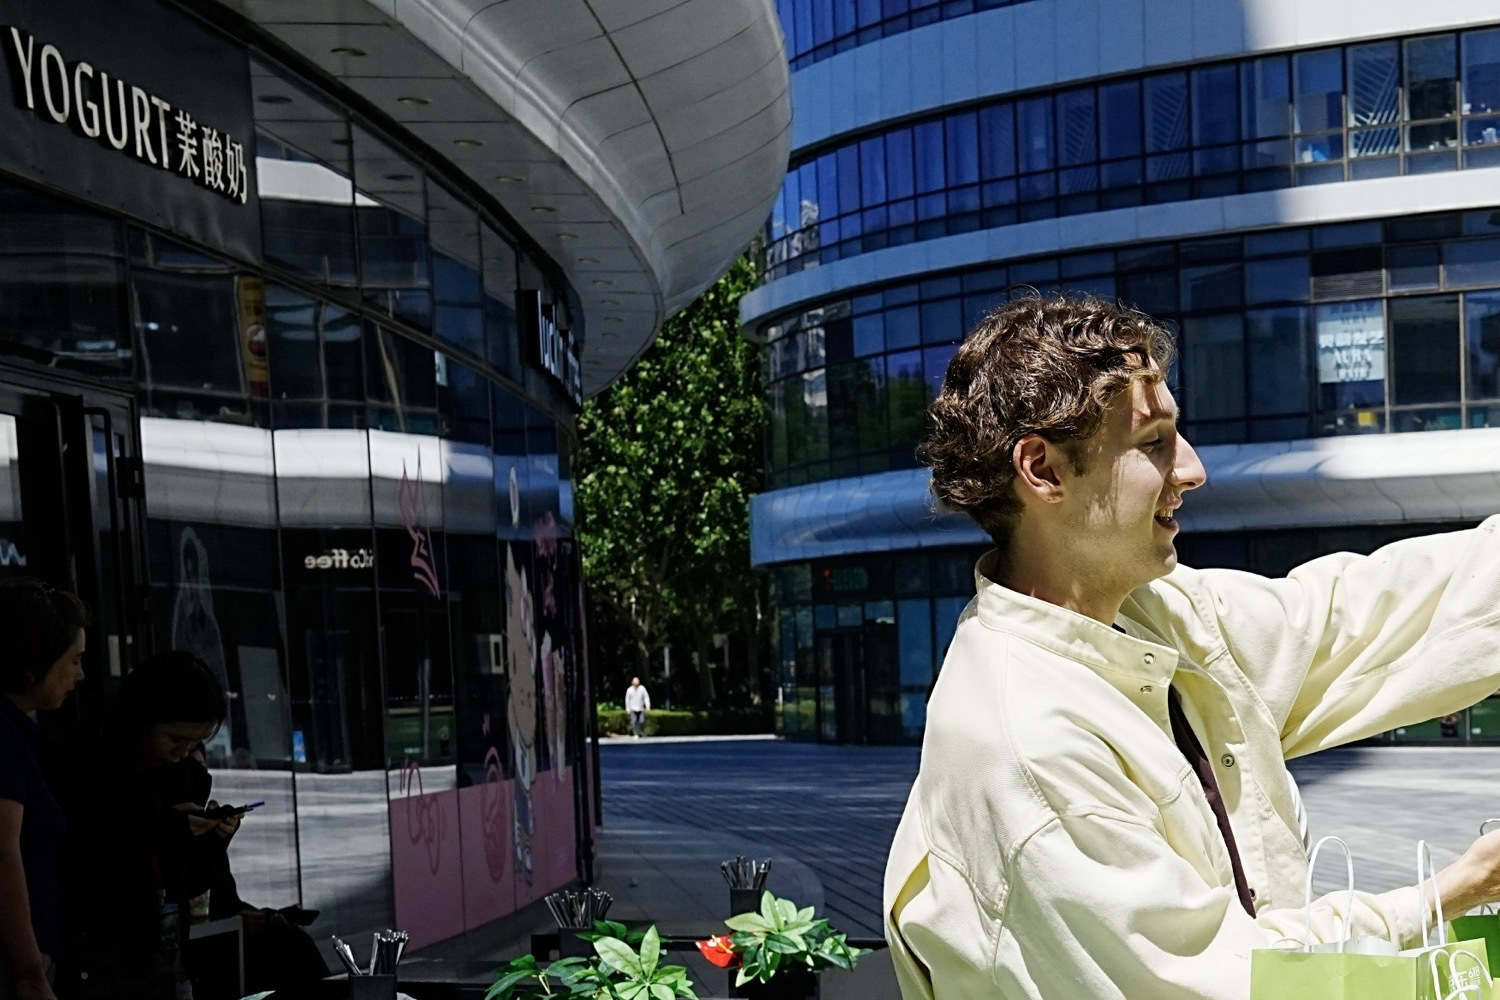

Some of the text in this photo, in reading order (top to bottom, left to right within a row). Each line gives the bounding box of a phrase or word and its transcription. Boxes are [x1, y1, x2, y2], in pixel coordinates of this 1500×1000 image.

[10, 26, 247, 204] YOGURT 茉酸奶
